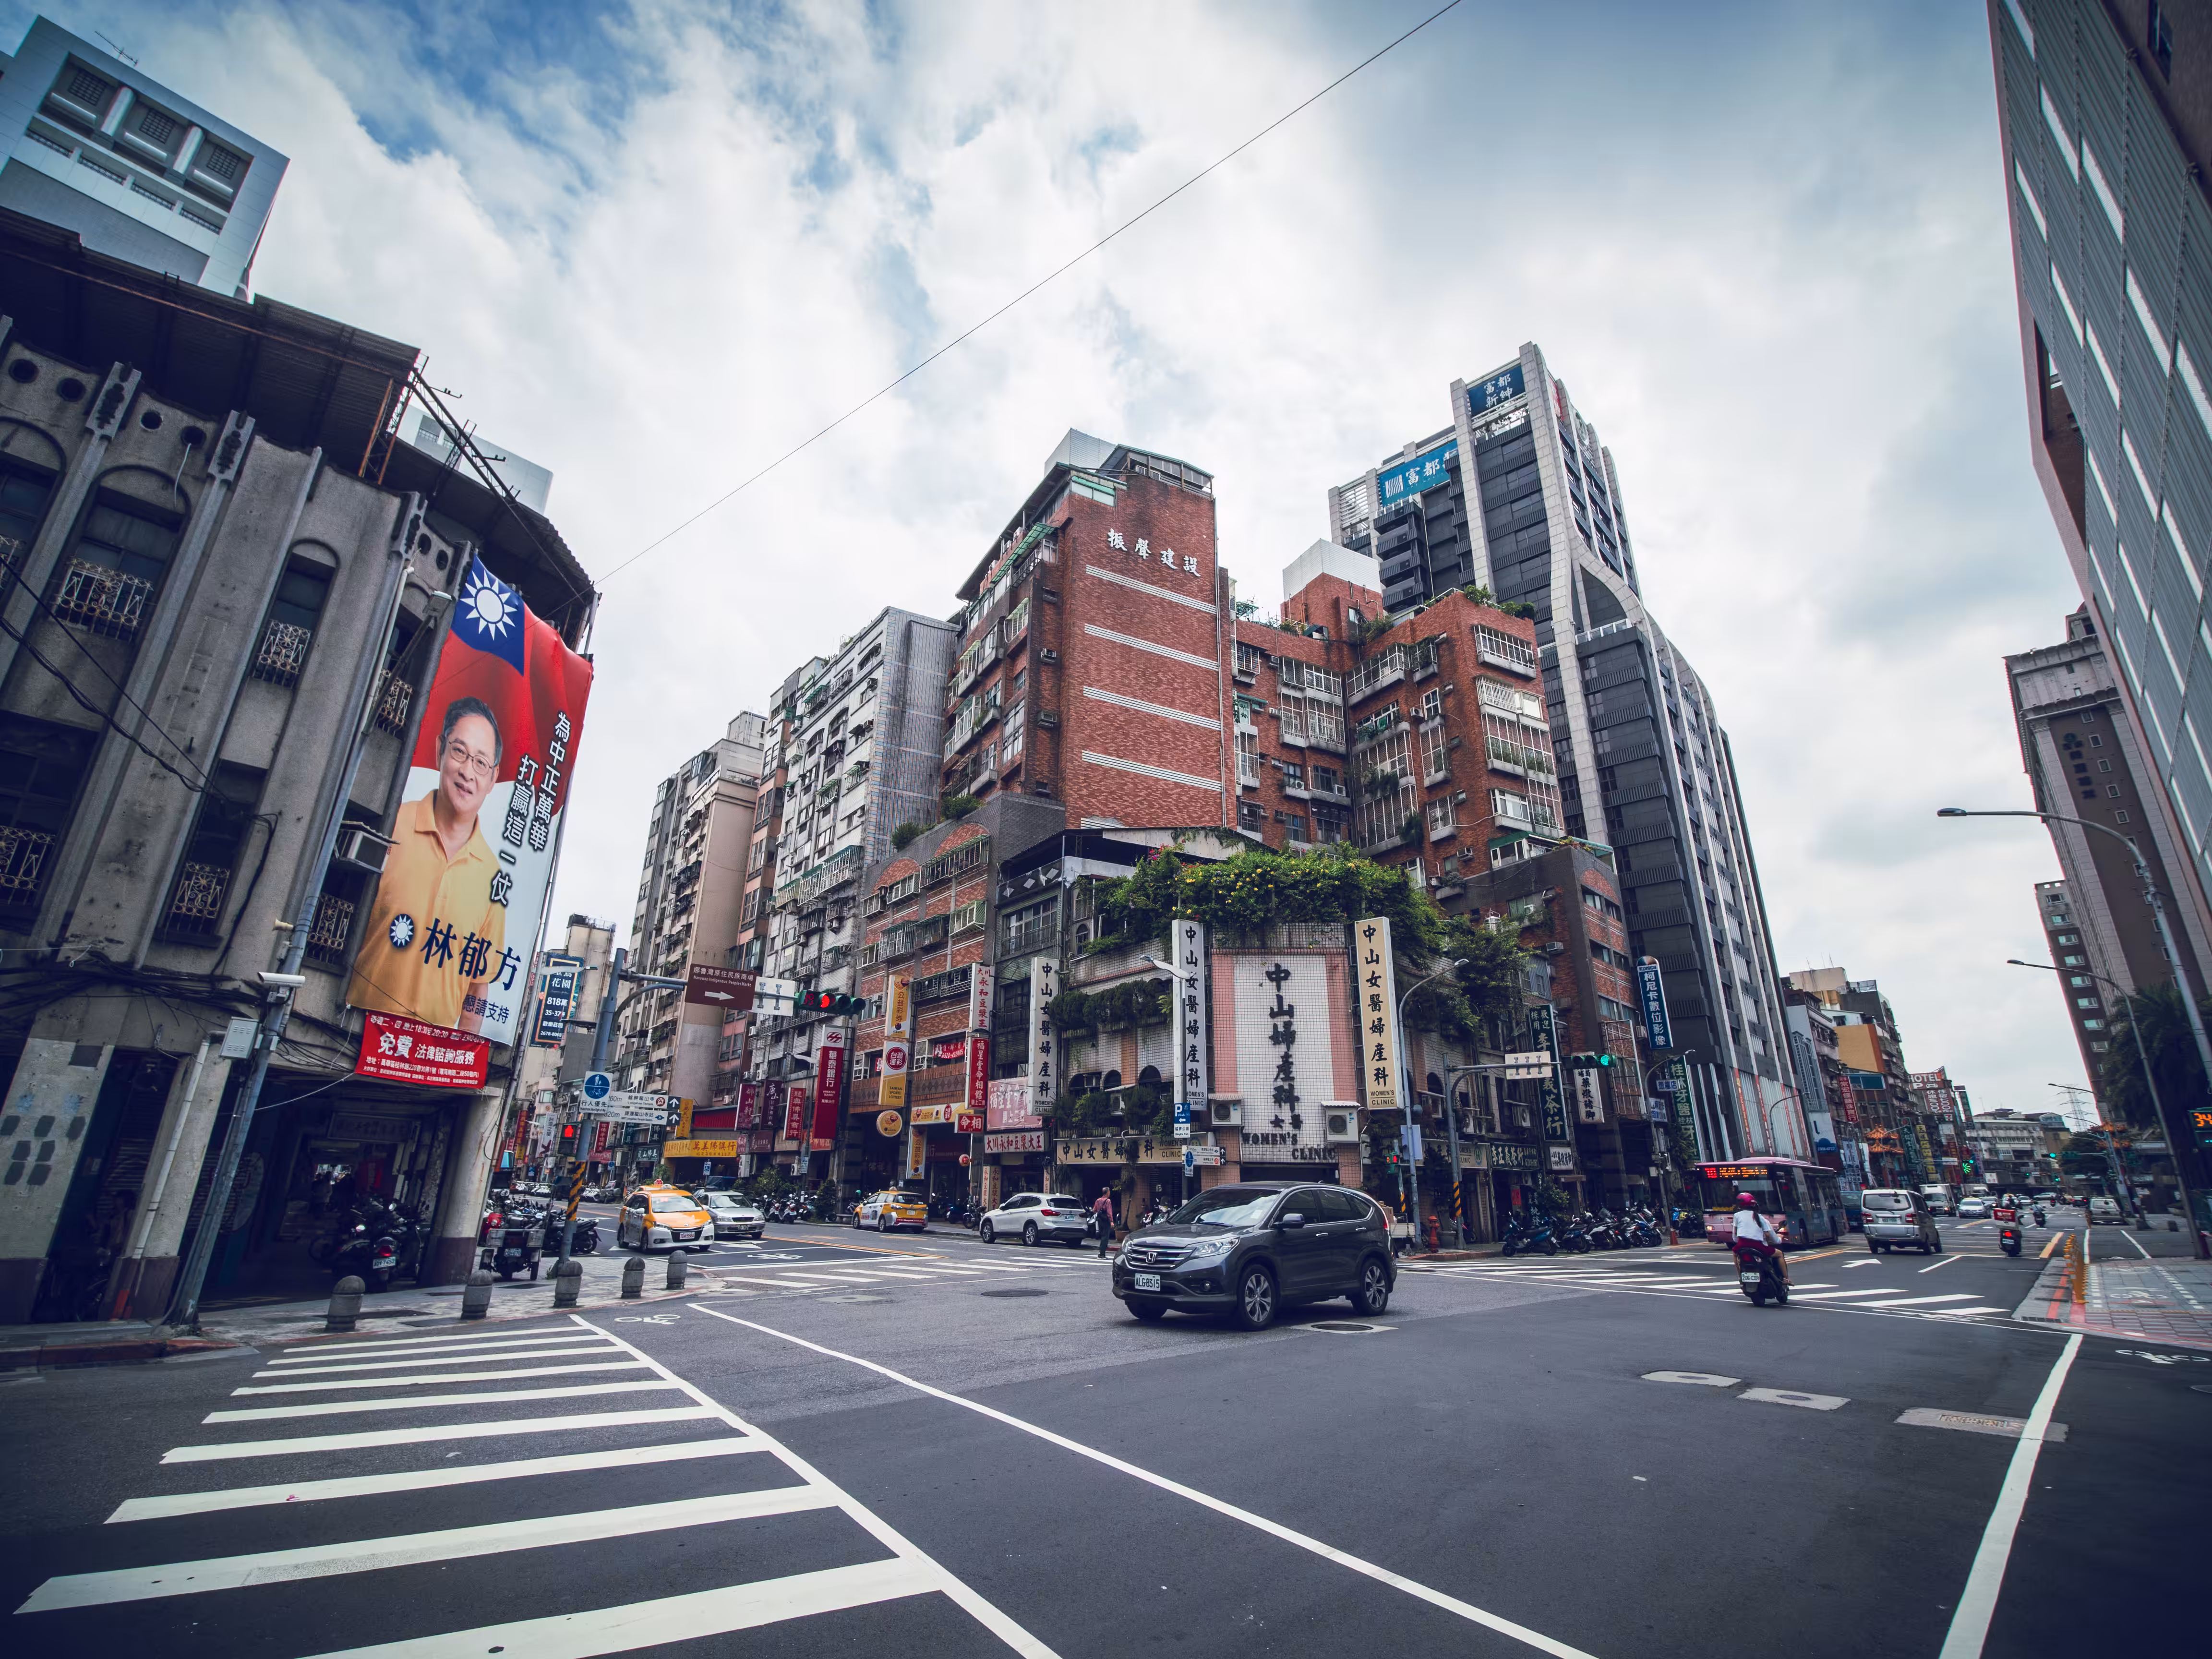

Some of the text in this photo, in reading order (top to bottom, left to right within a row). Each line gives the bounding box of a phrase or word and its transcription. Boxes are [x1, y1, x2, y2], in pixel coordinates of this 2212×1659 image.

[529, 711, 571, 850] 為中正萬華
[491, 754, 539, 906] 打贏這一仗
[420, 918, 521, 991] 林郁方
[552, 977, 571, 989] 花園
[693, 966, 754, 982] 娜魯灣原住民族商場
[463, 995, 509, 1024] 懇請支持
[547, 997, 568, 1006] 818萬
[1644, 971, 1666, 1046] 柯尼卡數位影像
[378, 1032, 475, 1066] 免費 法律諮詢服務
[826, 1050, 838, 1087] 華泰銀行
[975, 1040, 985, 1099] 福星堂命相館
[1370, 1089, 1395, 1097] WOMEN'S
[1537, 1033, 1563, 1135] 李義茶行
[960, 1116, 982, 1130] 命相
[1175, 1104, 1182, 1117] P
[2193, 1113, 2212, 1127] 34
[1062, 1139, 1154, 1161] 中山女醫婦科
[1242, 1131, 1298, 1145] WOMEN'S
